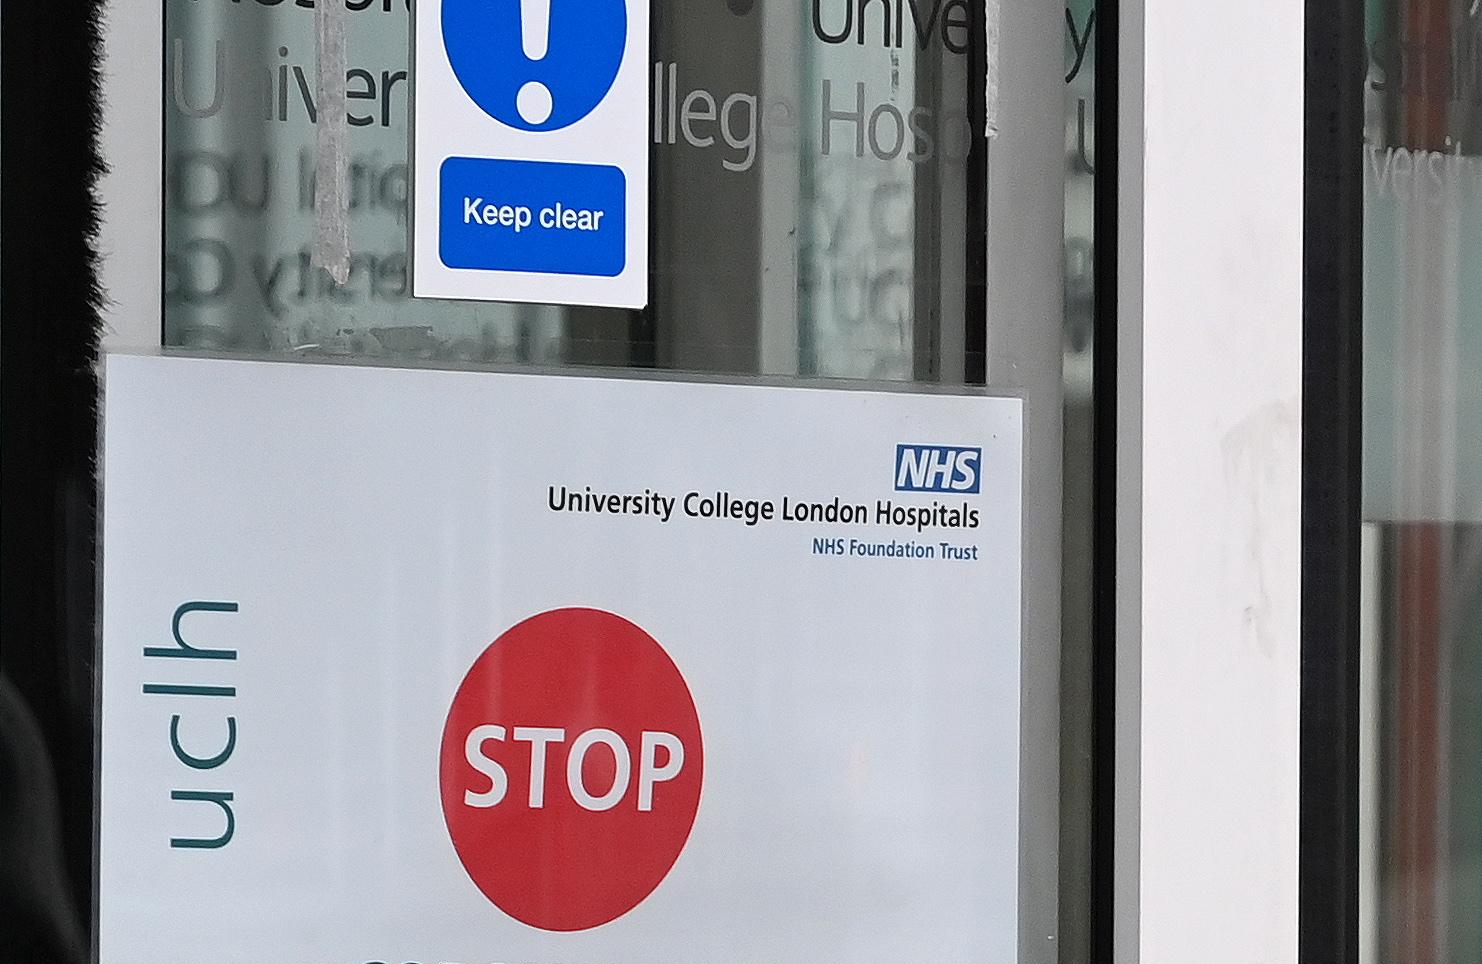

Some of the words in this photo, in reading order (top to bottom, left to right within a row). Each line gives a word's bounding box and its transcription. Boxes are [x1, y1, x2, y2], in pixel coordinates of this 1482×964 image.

[464, 197, 532, 232] Keep
[539, 202, 604, 230] clear
[897, 448, 979, 490] NHS
[548, 485, 676, 522] University
[683, 491, 774, 526] College
[782, 496, 868, 523] London
[877, 499, 980, 533] Hospitals
[812, 537, 845, 555] NHS
[849, 538, 935, 558] Foundation
[939, 542, 978, 560] Trust
[142, 600, 239, 849] uclh
[464, 724, 686, 811] STOP
